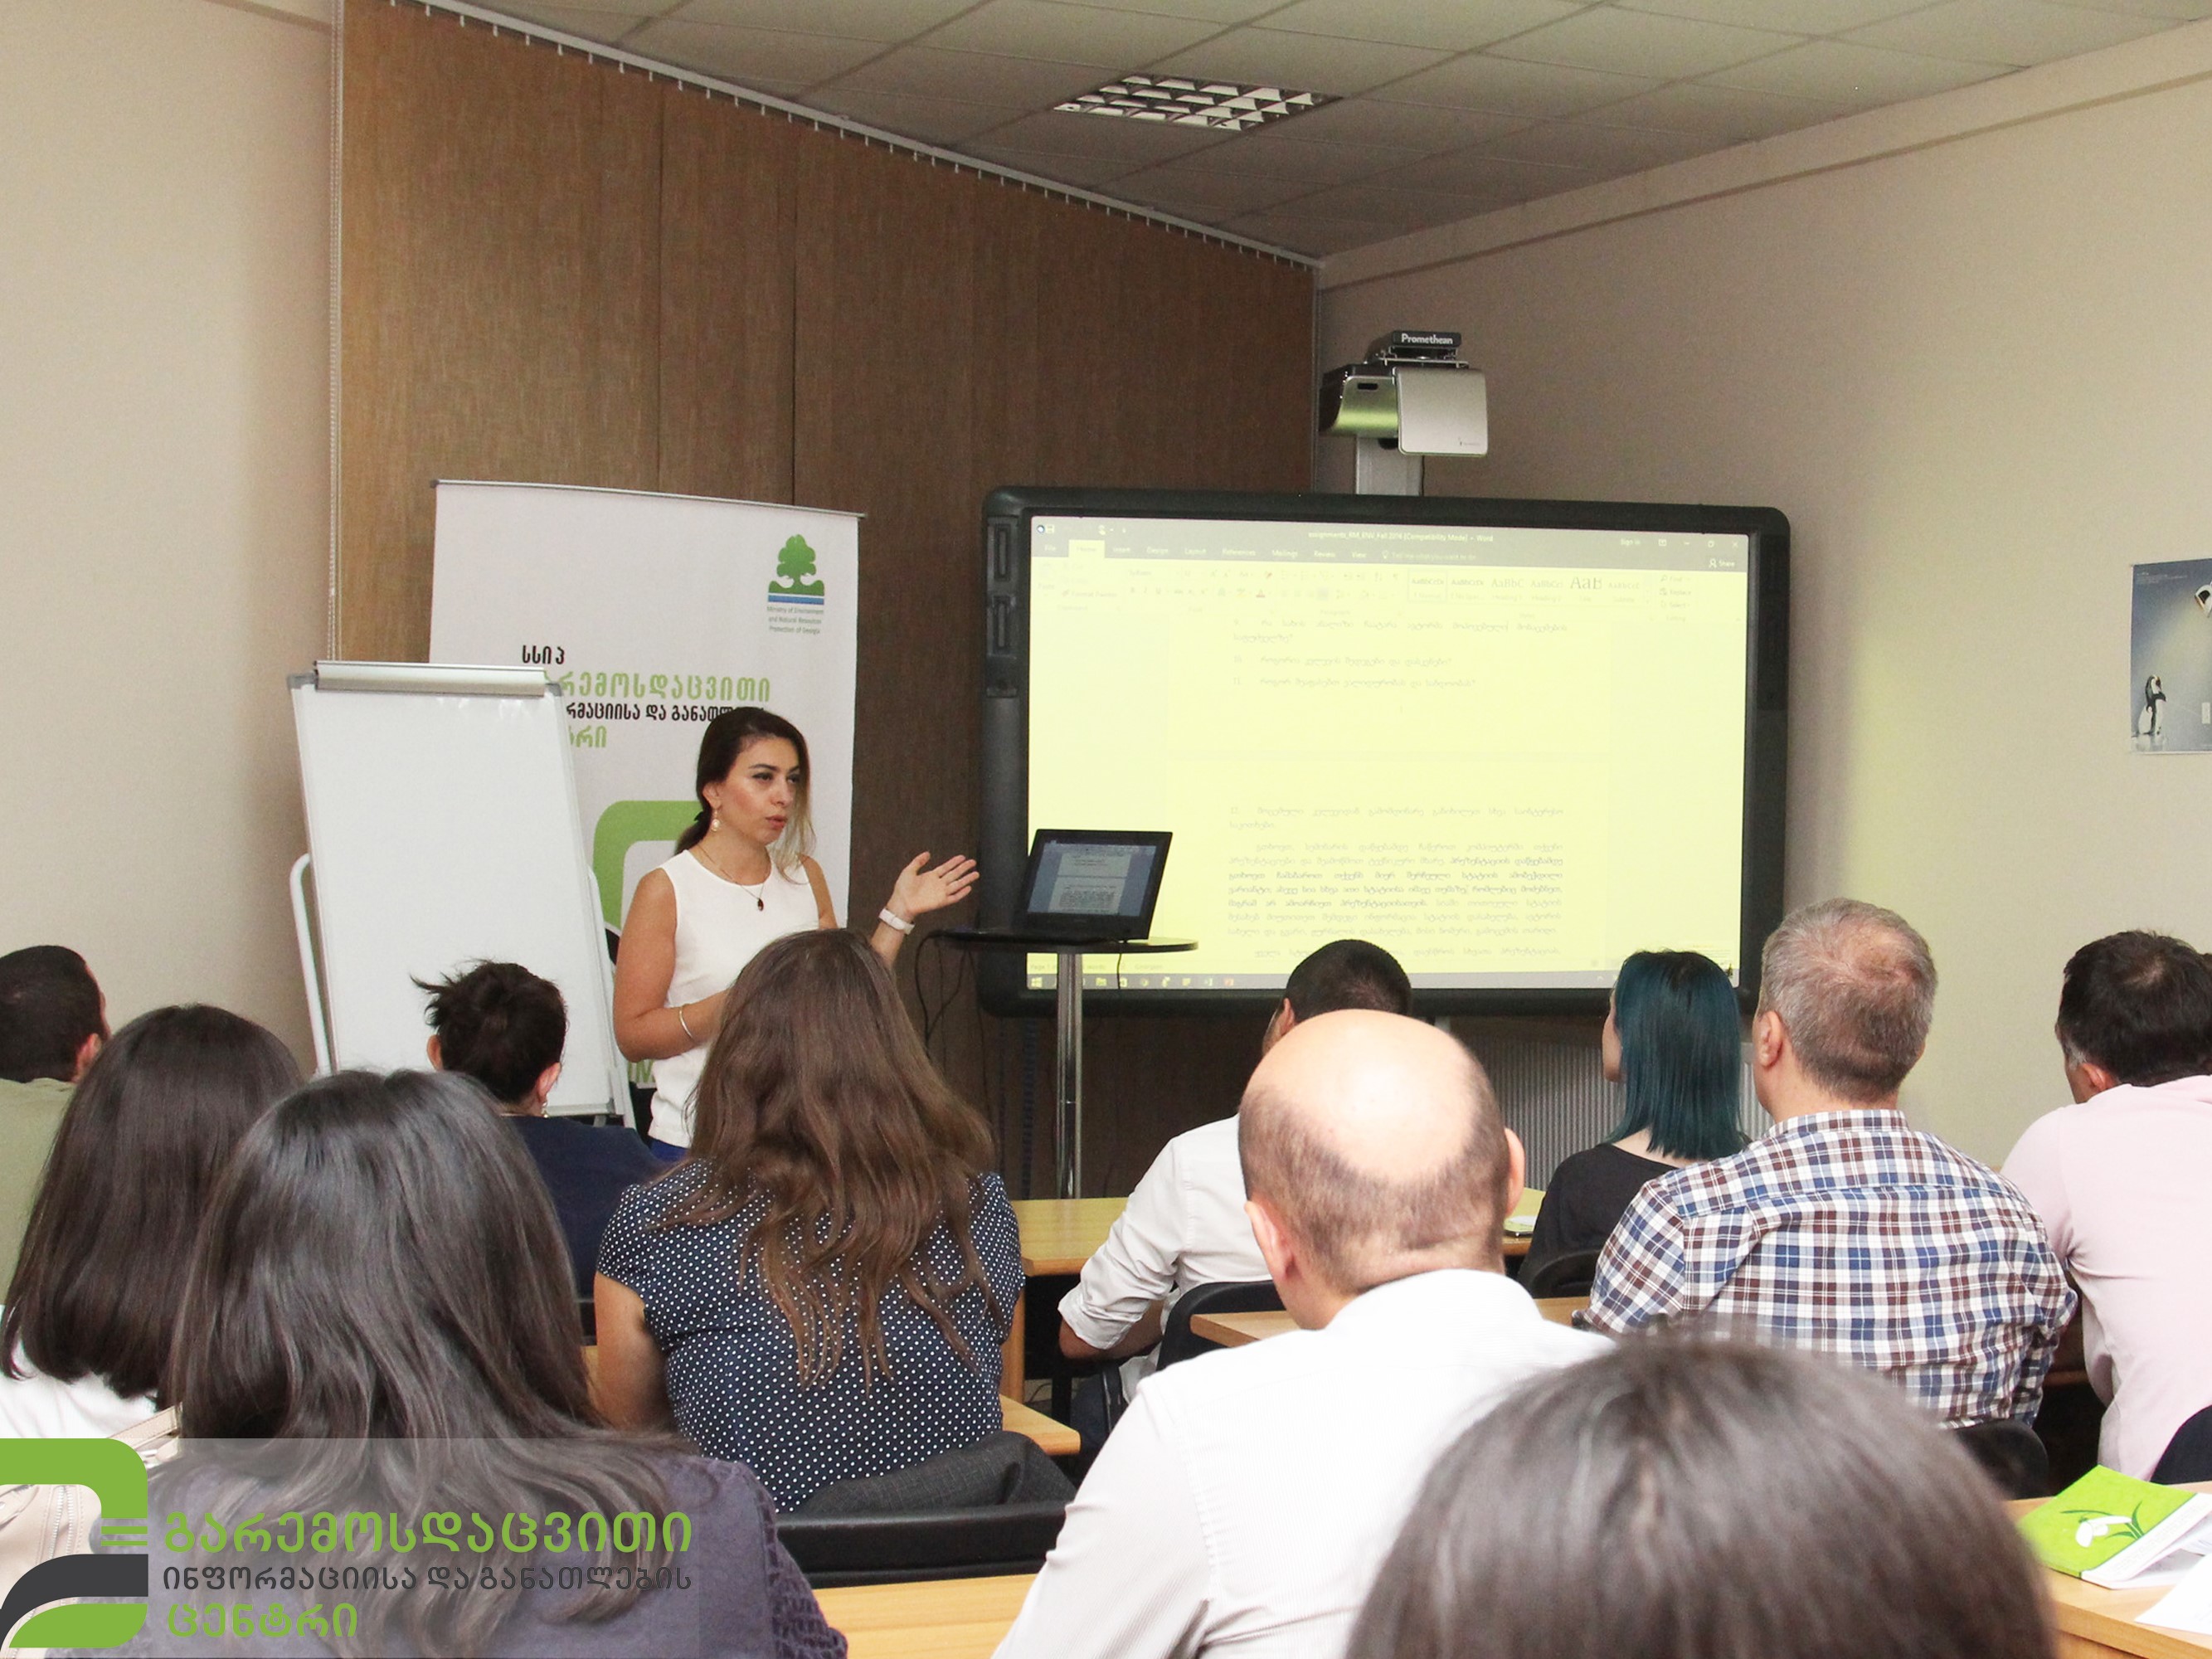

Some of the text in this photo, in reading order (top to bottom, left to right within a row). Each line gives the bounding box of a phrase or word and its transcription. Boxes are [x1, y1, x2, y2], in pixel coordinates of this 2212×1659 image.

[1401, 333, 1453, 344] Promethean
[1271, 548, 1299, 558] Mailings
[522, 645, 566, 664] სსიპ
[544, 669, 771, 703] რემოსდაცვითი
[566, 702, 640, 721] რმაციისა
[646, 704, 666, 721] და
